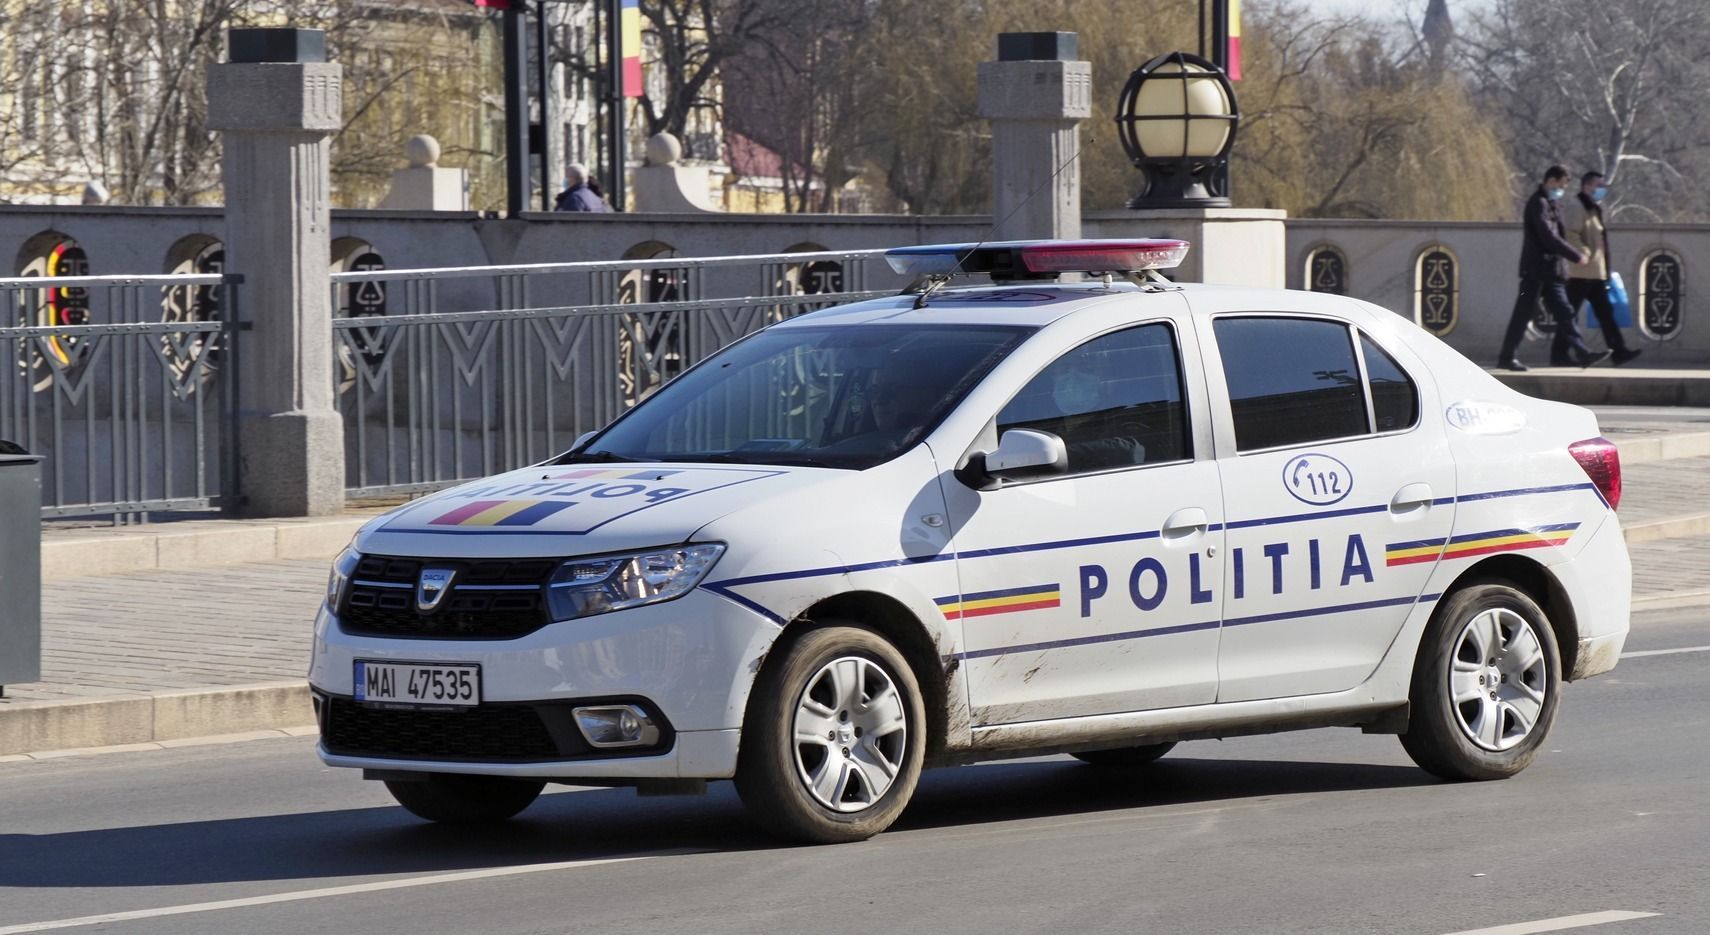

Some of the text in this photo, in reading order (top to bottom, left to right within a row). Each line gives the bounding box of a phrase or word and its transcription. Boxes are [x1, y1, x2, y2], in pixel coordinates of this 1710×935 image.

[1307, 471, 1341, 495] 112
[1079, 533, 1375, 618] POLITIA
[367, 666, 396, 698] MAI
[407, 669, 472, 701] 47535
